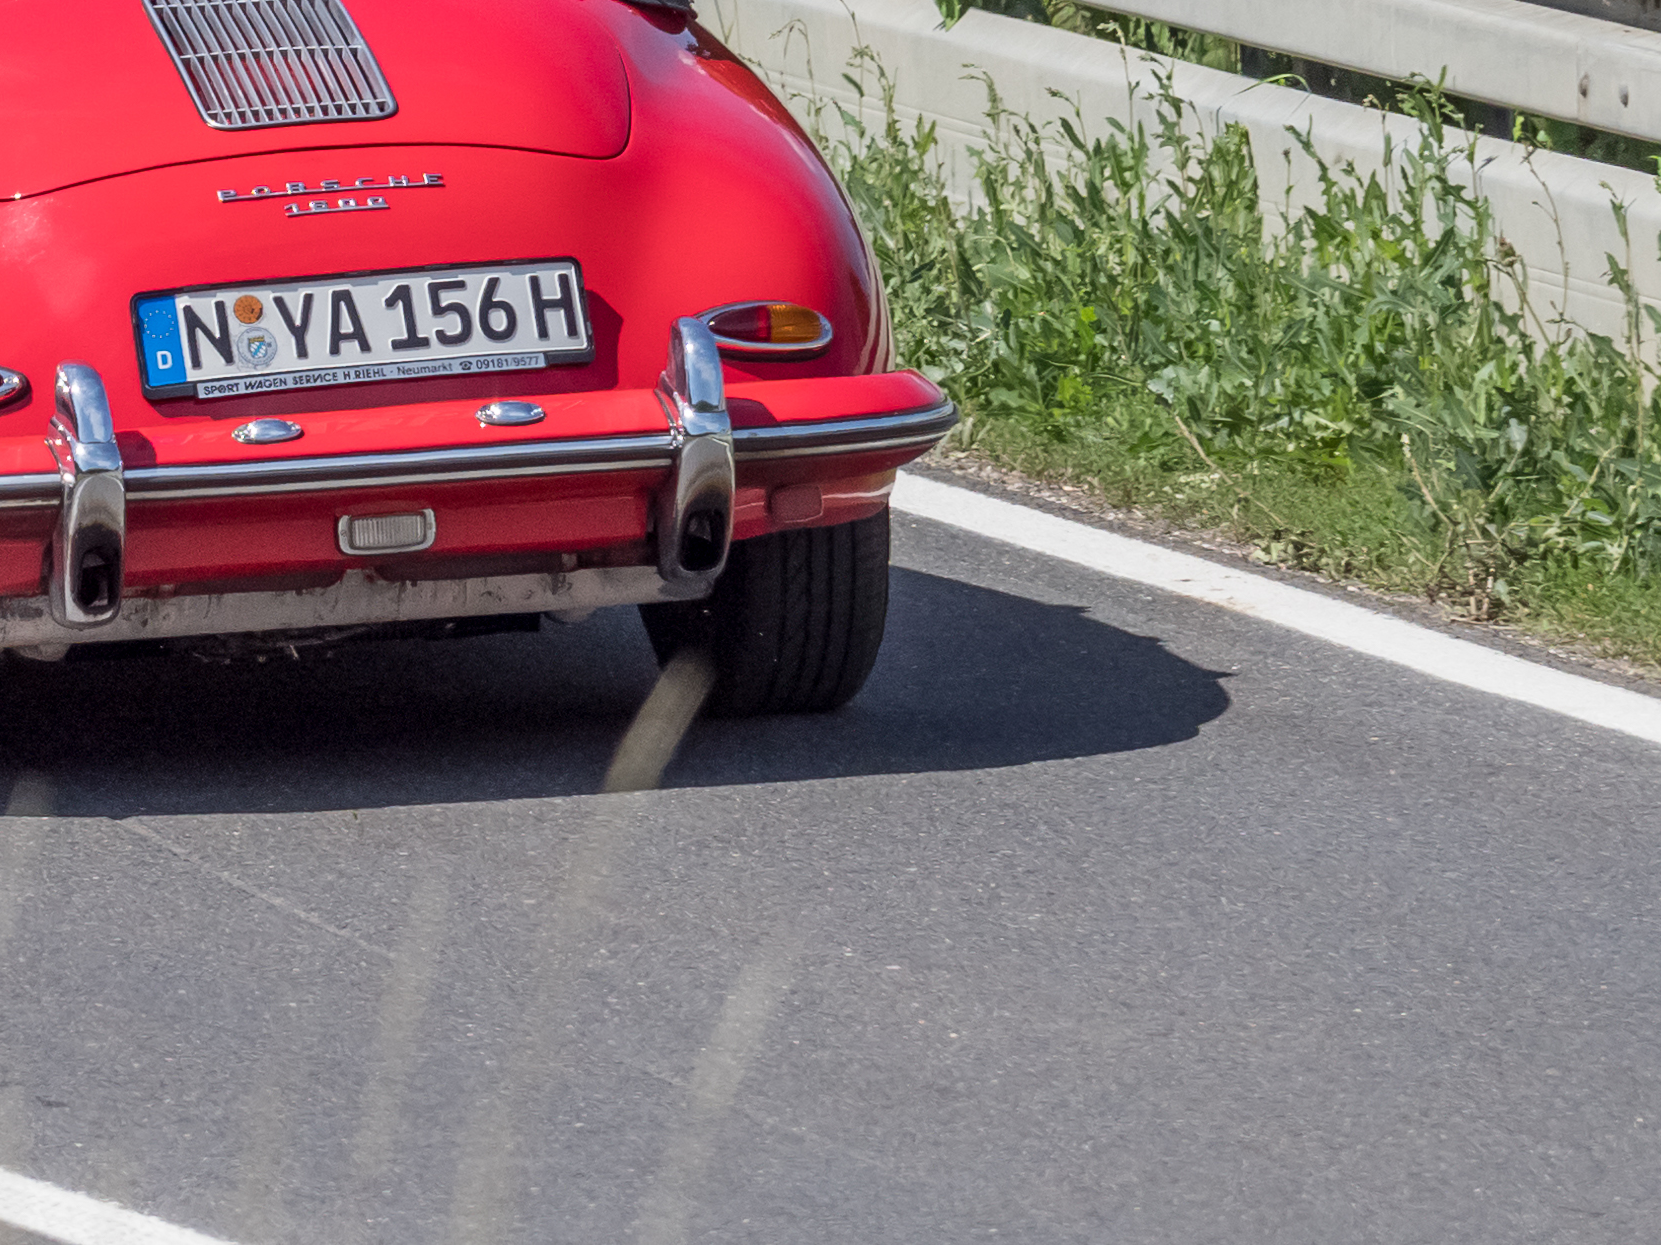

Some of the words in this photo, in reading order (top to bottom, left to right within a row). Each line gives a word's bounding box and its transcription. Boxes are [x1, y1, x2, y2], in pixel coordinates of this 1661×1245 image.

[217, 173, 444, 203] PORSCHE
[182, 300, 234, 368] N
[273, 289, 371, 358] YA
[159, 351, 172, 369] D
[203, 382, 240, 396] SPORT
[244, 377, 288, 391] WAGEN
[292, 371, 338, 386] SERVICE
[396, 362, 453, 376] Neumarkt
